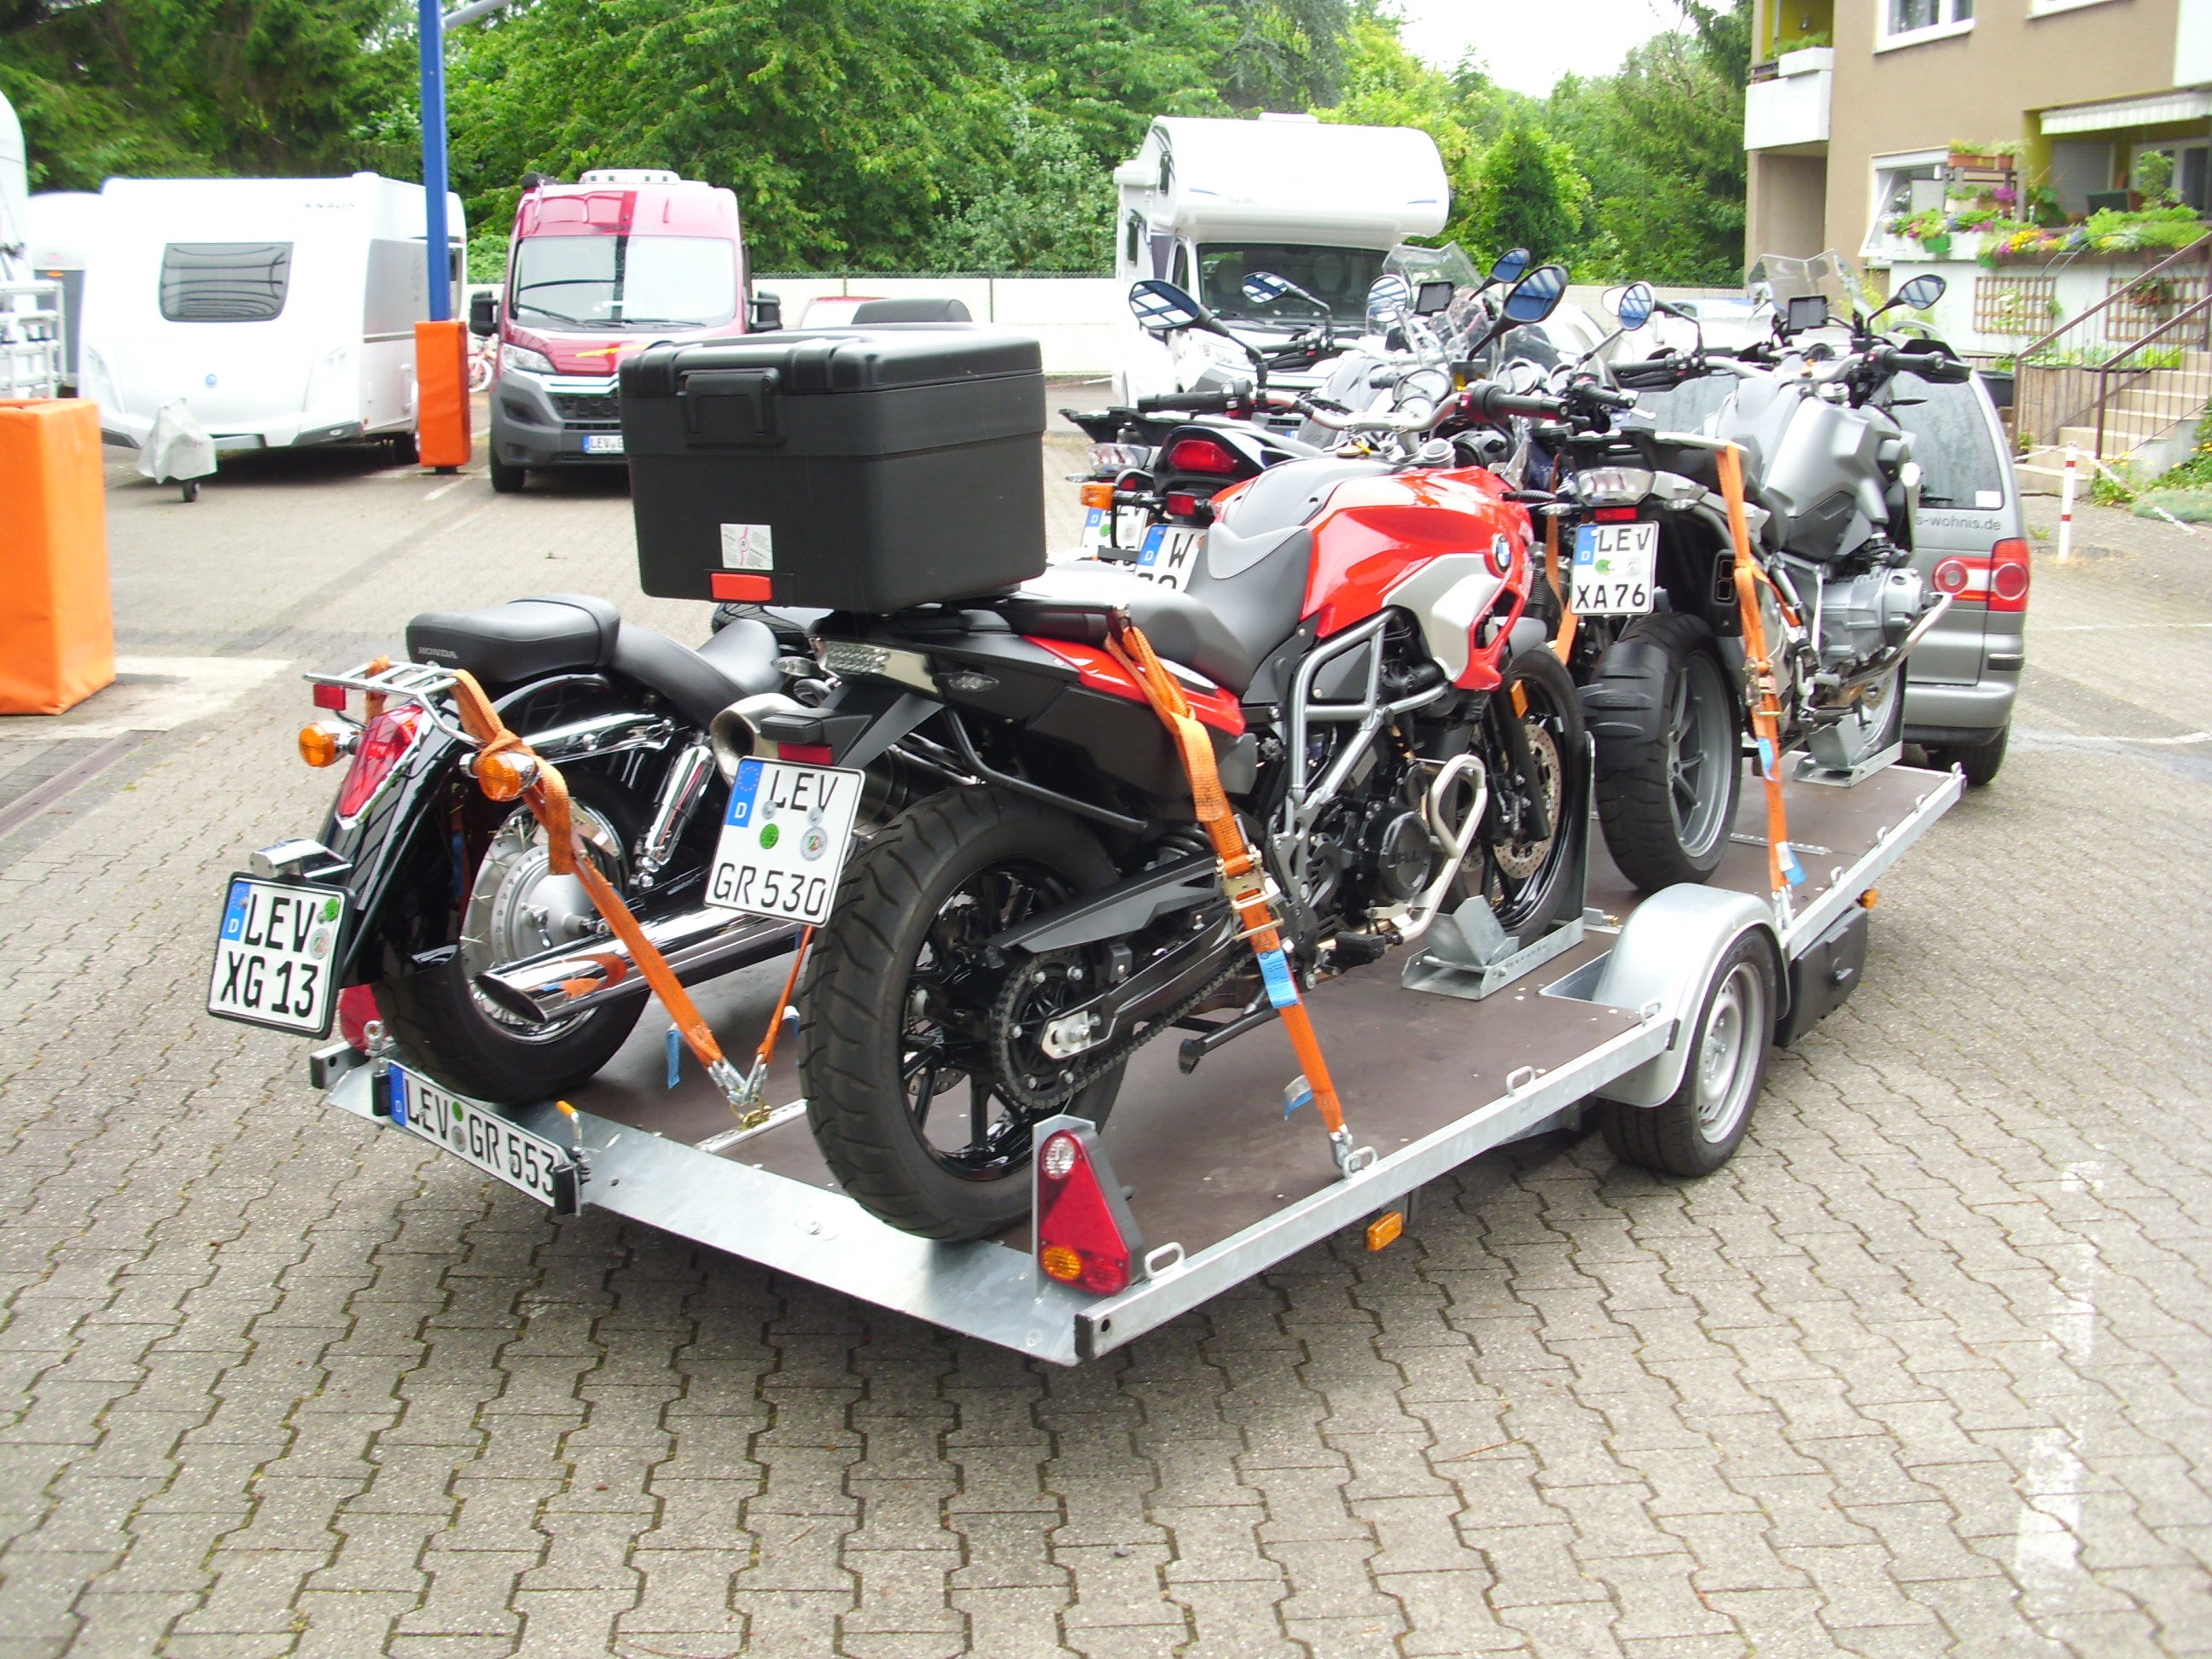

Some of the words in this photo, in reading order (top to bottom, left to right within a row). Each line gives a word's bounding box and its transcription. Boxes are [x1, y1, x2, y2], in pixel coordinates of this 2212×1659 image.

[591, 437, 611, 449] LEV
[1091, 514, 1099, 524] D
[1914, 515, 2001, 531] s-wohnis.de
[1598, 527, 1651, 552] LEV
[1144, 550, 1155, 562] D
[1168, 533, 1195, 568] W
[1580, 550, 1590, 562] D
[1575, 584, 1608, 609] XA
[1615, 583, 1646, 608] 76
[417, 646, 459, 659] HONDA
[770, 769, 839, 813] LEV
[734, 801, 748, 819] D
[713, 862, 757, 905] GR
[760, 870, 827, 917] 530
[228, 917, 240, 934] D
[244, 894, 317, 953] LEV
[220, 950, 266, 1009] XG
[271, 960, 319, 1018] 13
[405, 1078, 449, 1141] LEV
[469, 1113, 502, 1170] GR
[507, 1132, 555, 1198] 553
